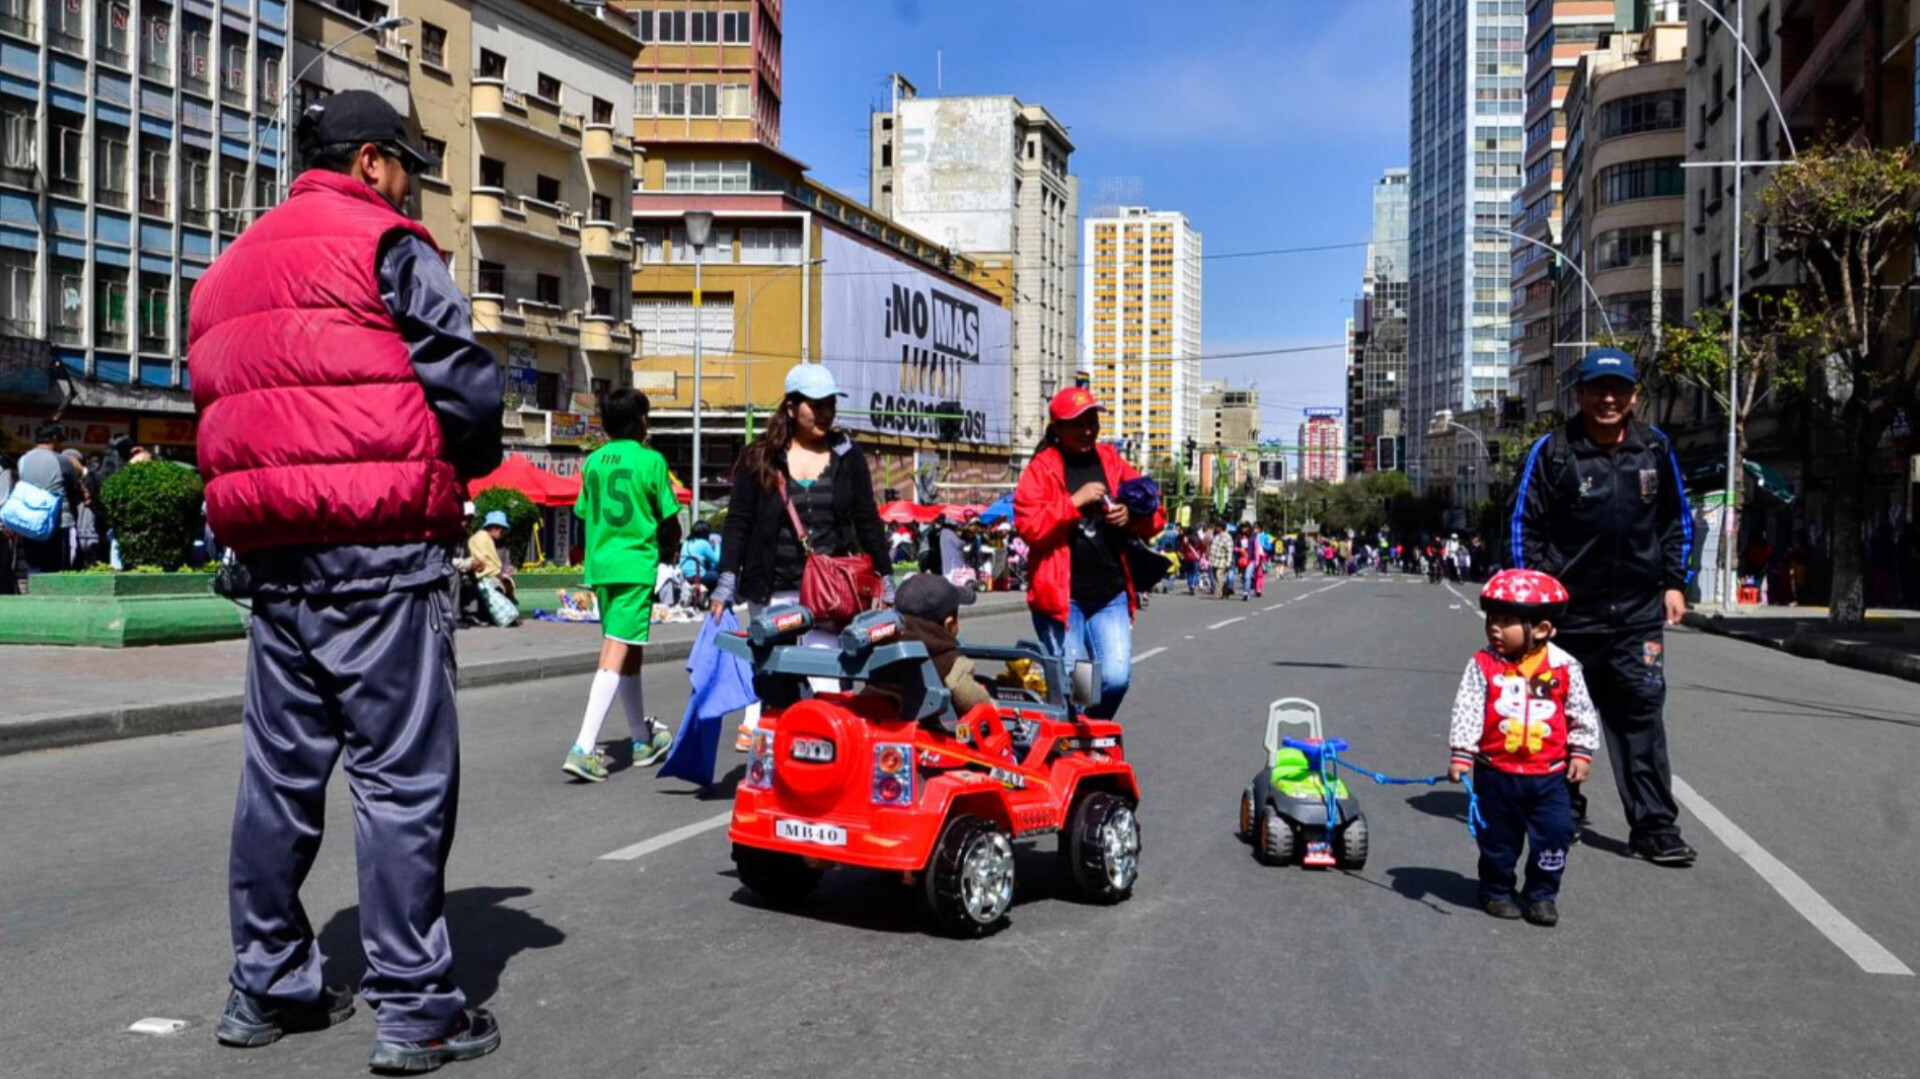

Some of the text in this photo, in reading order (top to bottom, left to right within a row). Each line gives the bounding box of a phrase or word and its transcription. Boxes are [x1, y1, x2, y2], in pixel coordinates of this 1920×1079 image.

[181, 54, 280, 99] DENTL
[884, 282, 929, 339] ¡NO
[587, 468, 635, 528] 15
[785, 823, 838, 842] MB40
